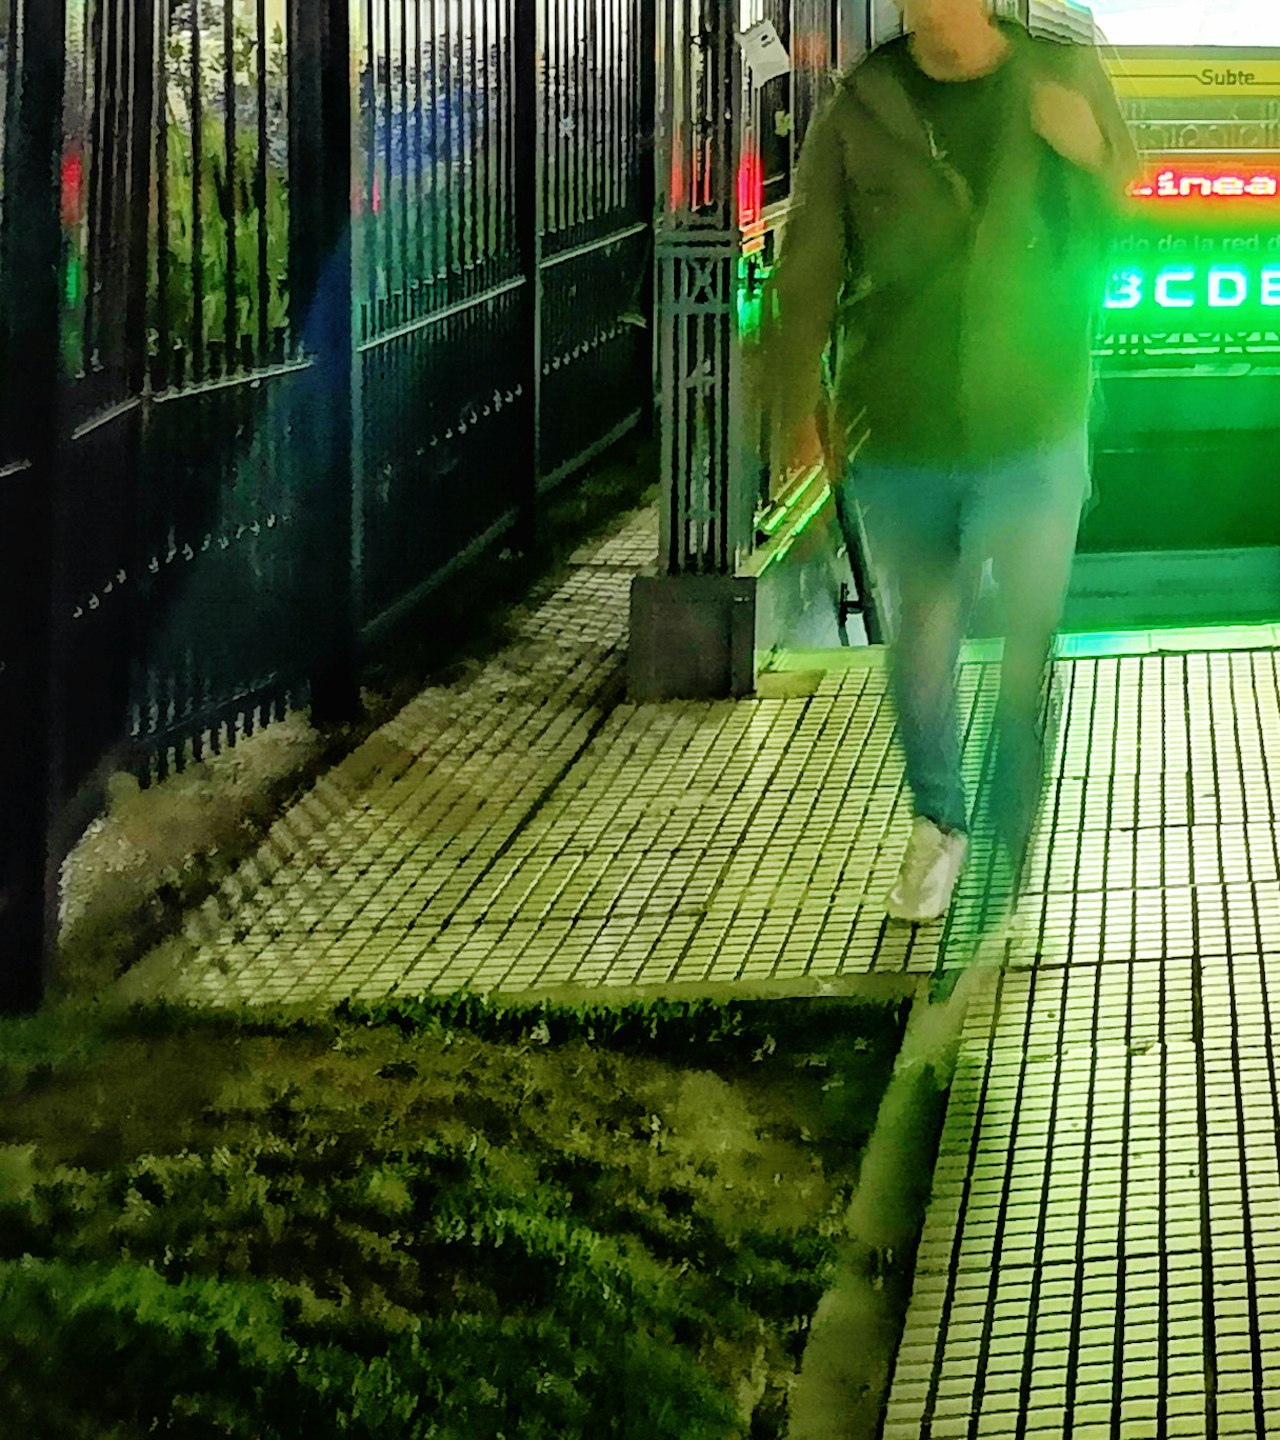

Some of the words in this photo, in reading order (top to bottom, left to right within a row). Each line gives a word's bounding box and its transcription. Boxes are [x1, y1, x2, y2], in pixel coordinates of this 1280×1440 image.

[1200, 68, 1256, 87] Subte
[1157, 234, 1188, 254] de
[1193, 234, 1215, 254] la
[1221, 234, 1260, 254] red
